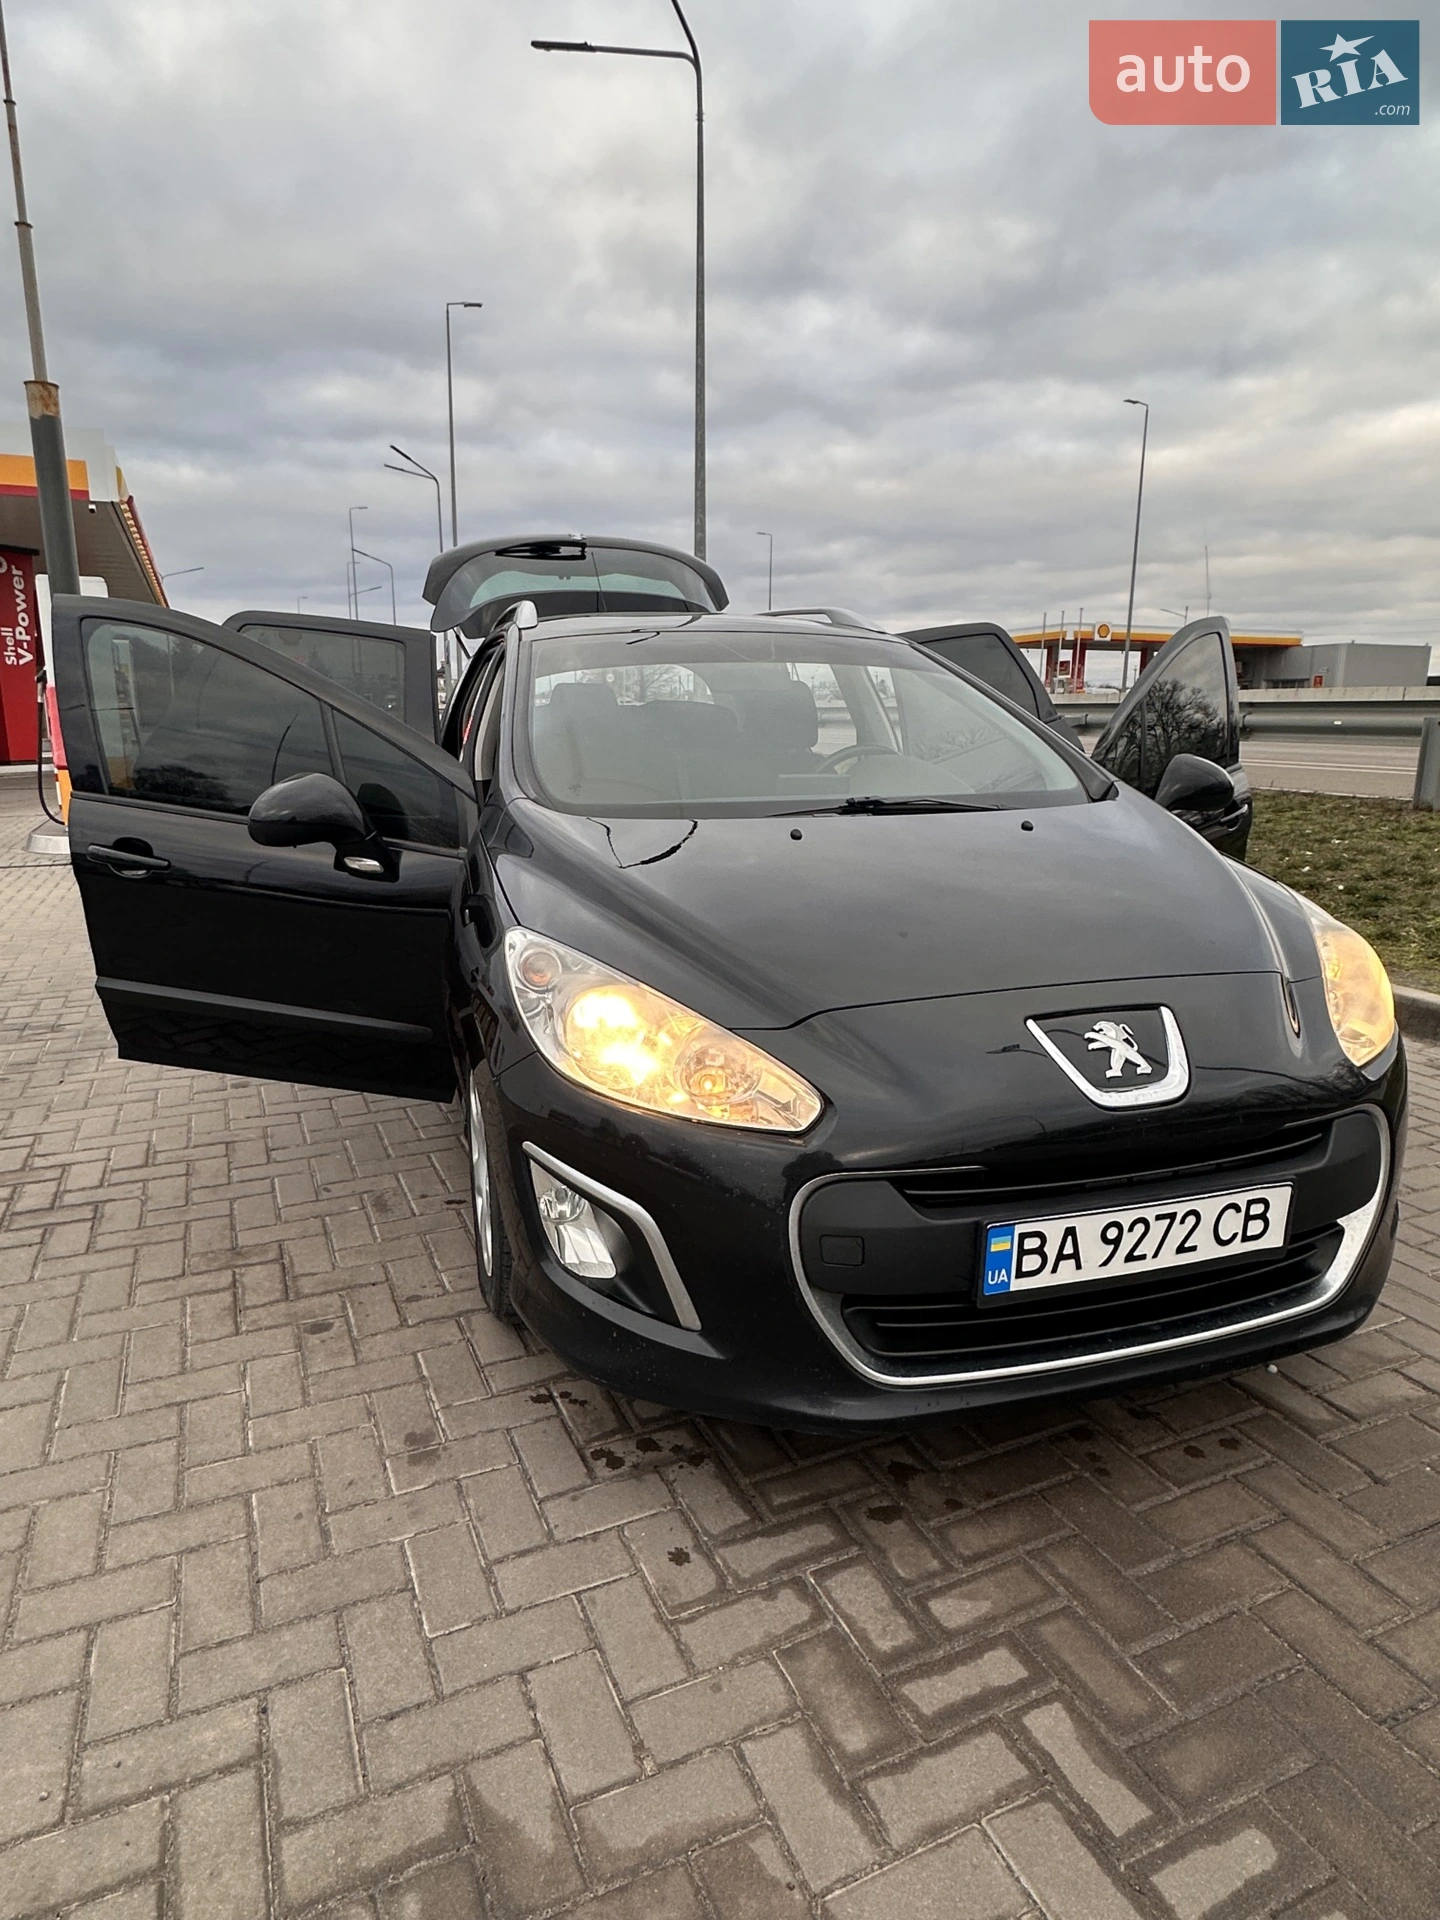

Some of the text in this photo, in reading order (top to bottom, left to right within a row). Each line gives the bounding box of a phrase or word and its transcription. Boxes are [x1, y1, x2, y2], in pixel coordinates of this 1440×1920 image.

[11, 565, 34, 665] V-Power
[1, 627, 17, 665] Shell
[1014, 1196, 1271, 1279] BA 9272 CB
[987, 1268, 1009, 1286] UA
